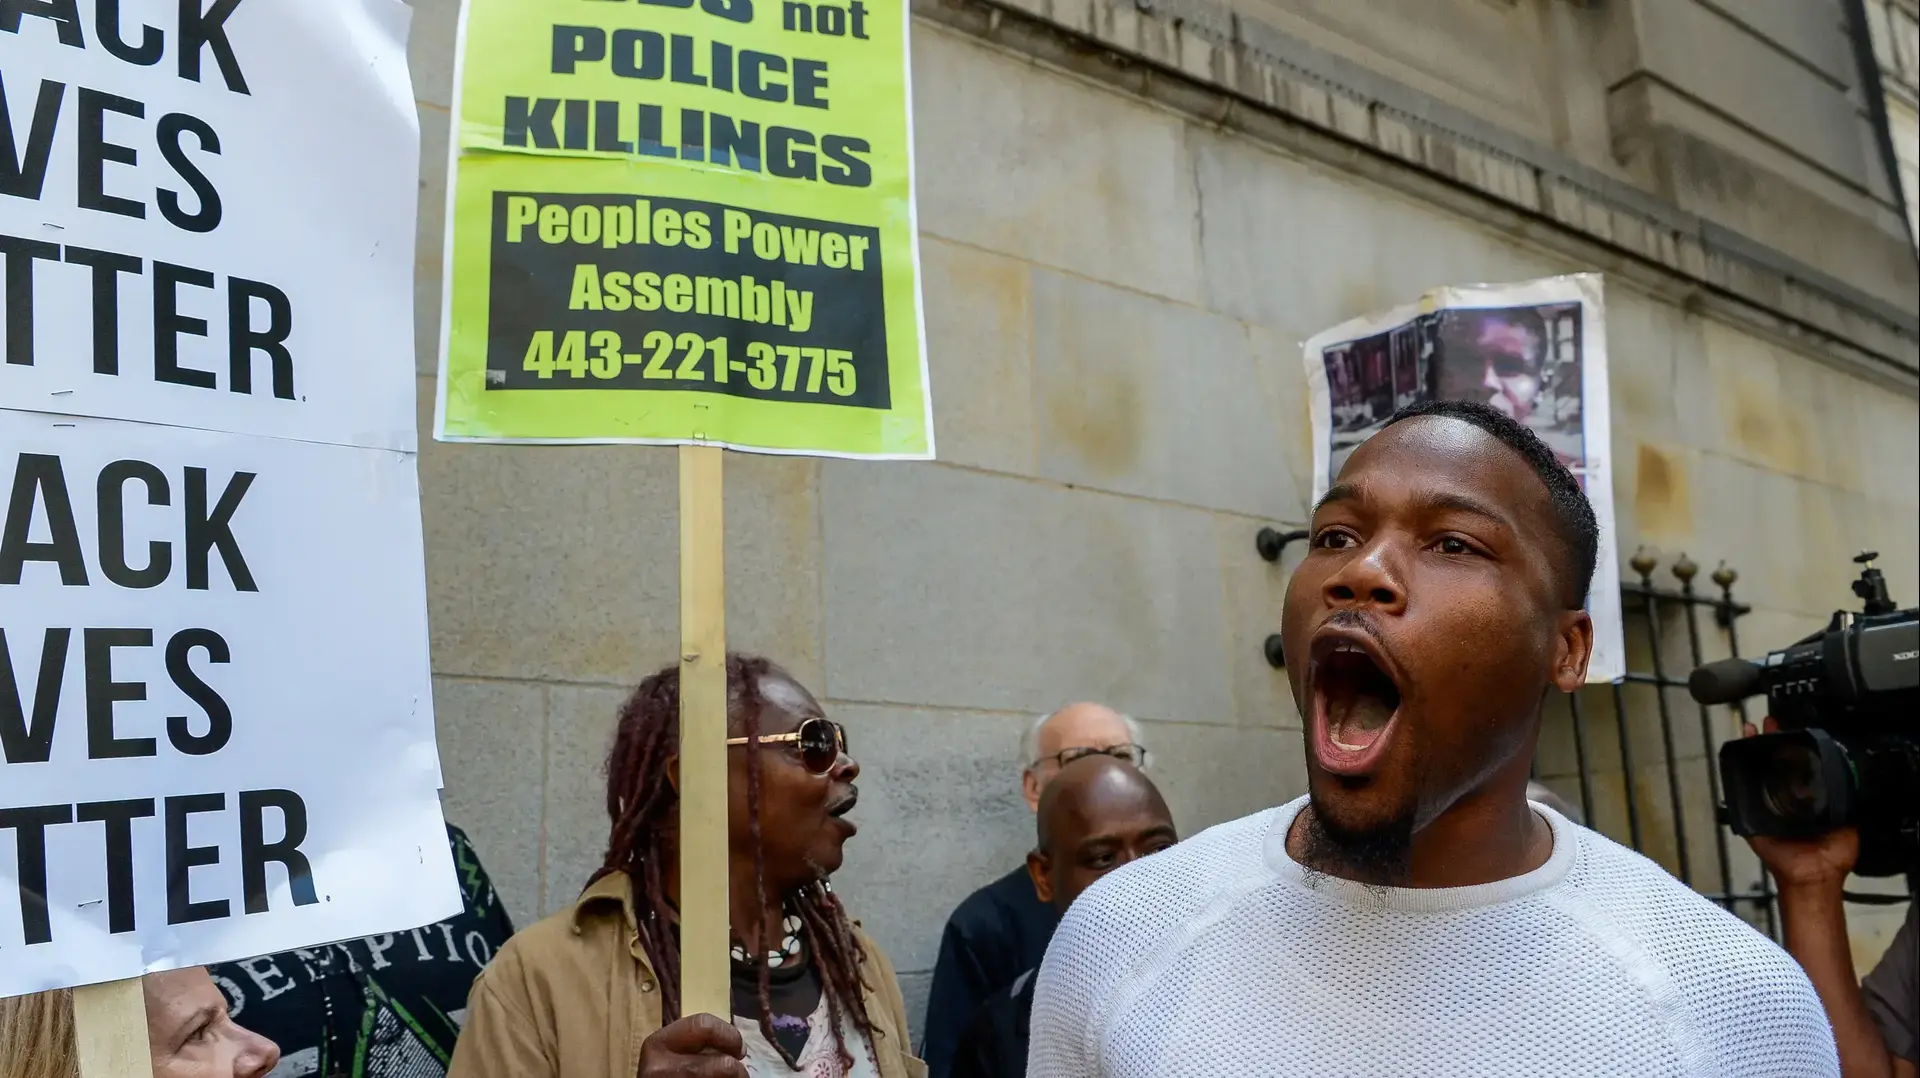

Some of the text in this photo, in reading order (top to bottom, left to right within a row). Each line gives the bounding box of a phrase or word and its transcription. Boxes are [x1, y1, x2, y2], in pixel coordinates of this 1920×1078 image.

[783, 1, 870, 40] not
[551, 24, 829, 110] POLICE
[0, 70, 222, 233] VES
[503, 95, 872, 188] KILLINGS
[506, 196, 870, 271] Peoples Power
[568, 264, 814, 333] Assembly
[522, 330, 857, 397] 443-221-3775
[0, 452, 259, 593] ACK
[0, 627, 233, 764] VES
